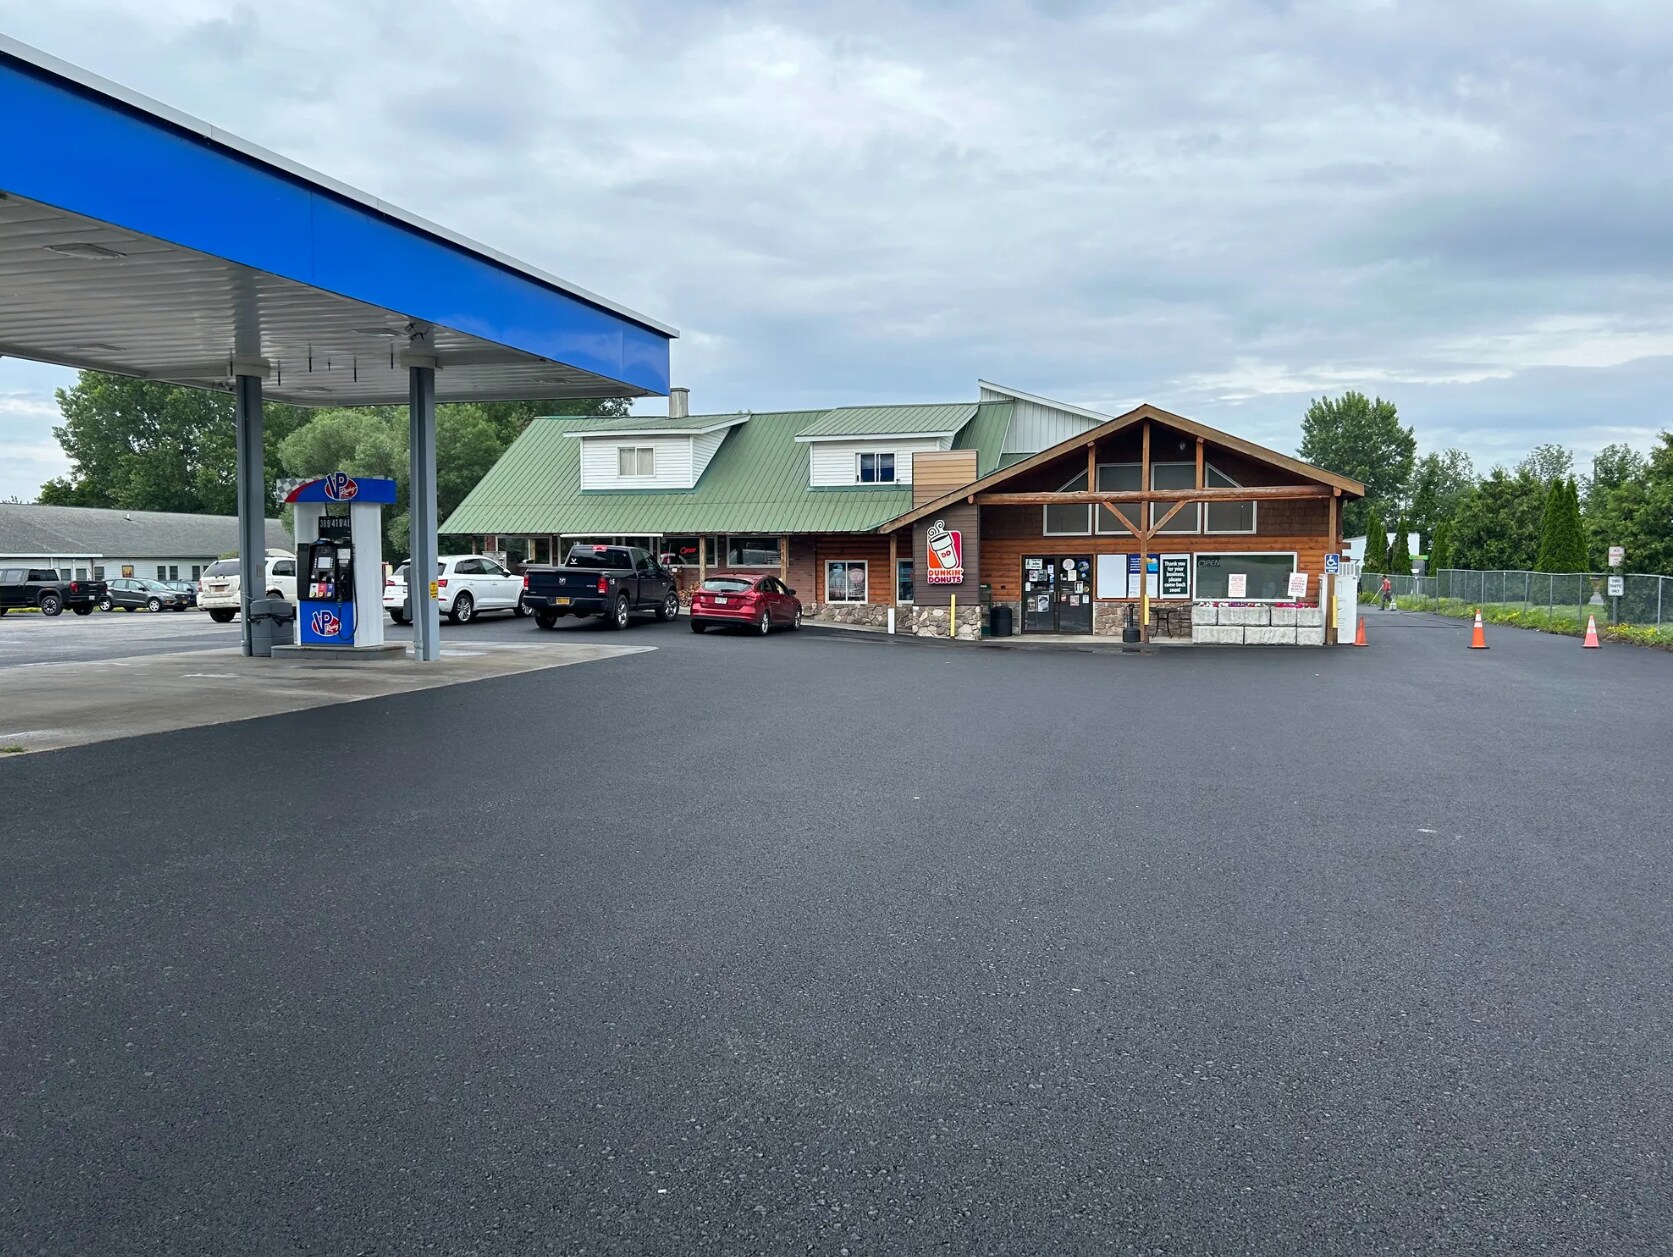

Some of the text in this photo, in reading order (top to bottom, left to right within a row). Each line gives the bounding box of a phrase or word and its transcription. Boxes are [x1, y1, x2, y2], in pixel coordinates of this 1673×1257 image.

[326, 472, 348, 499] VP
[941, 550, 951, 558] DD
[312, 610, 333, 635] VP
